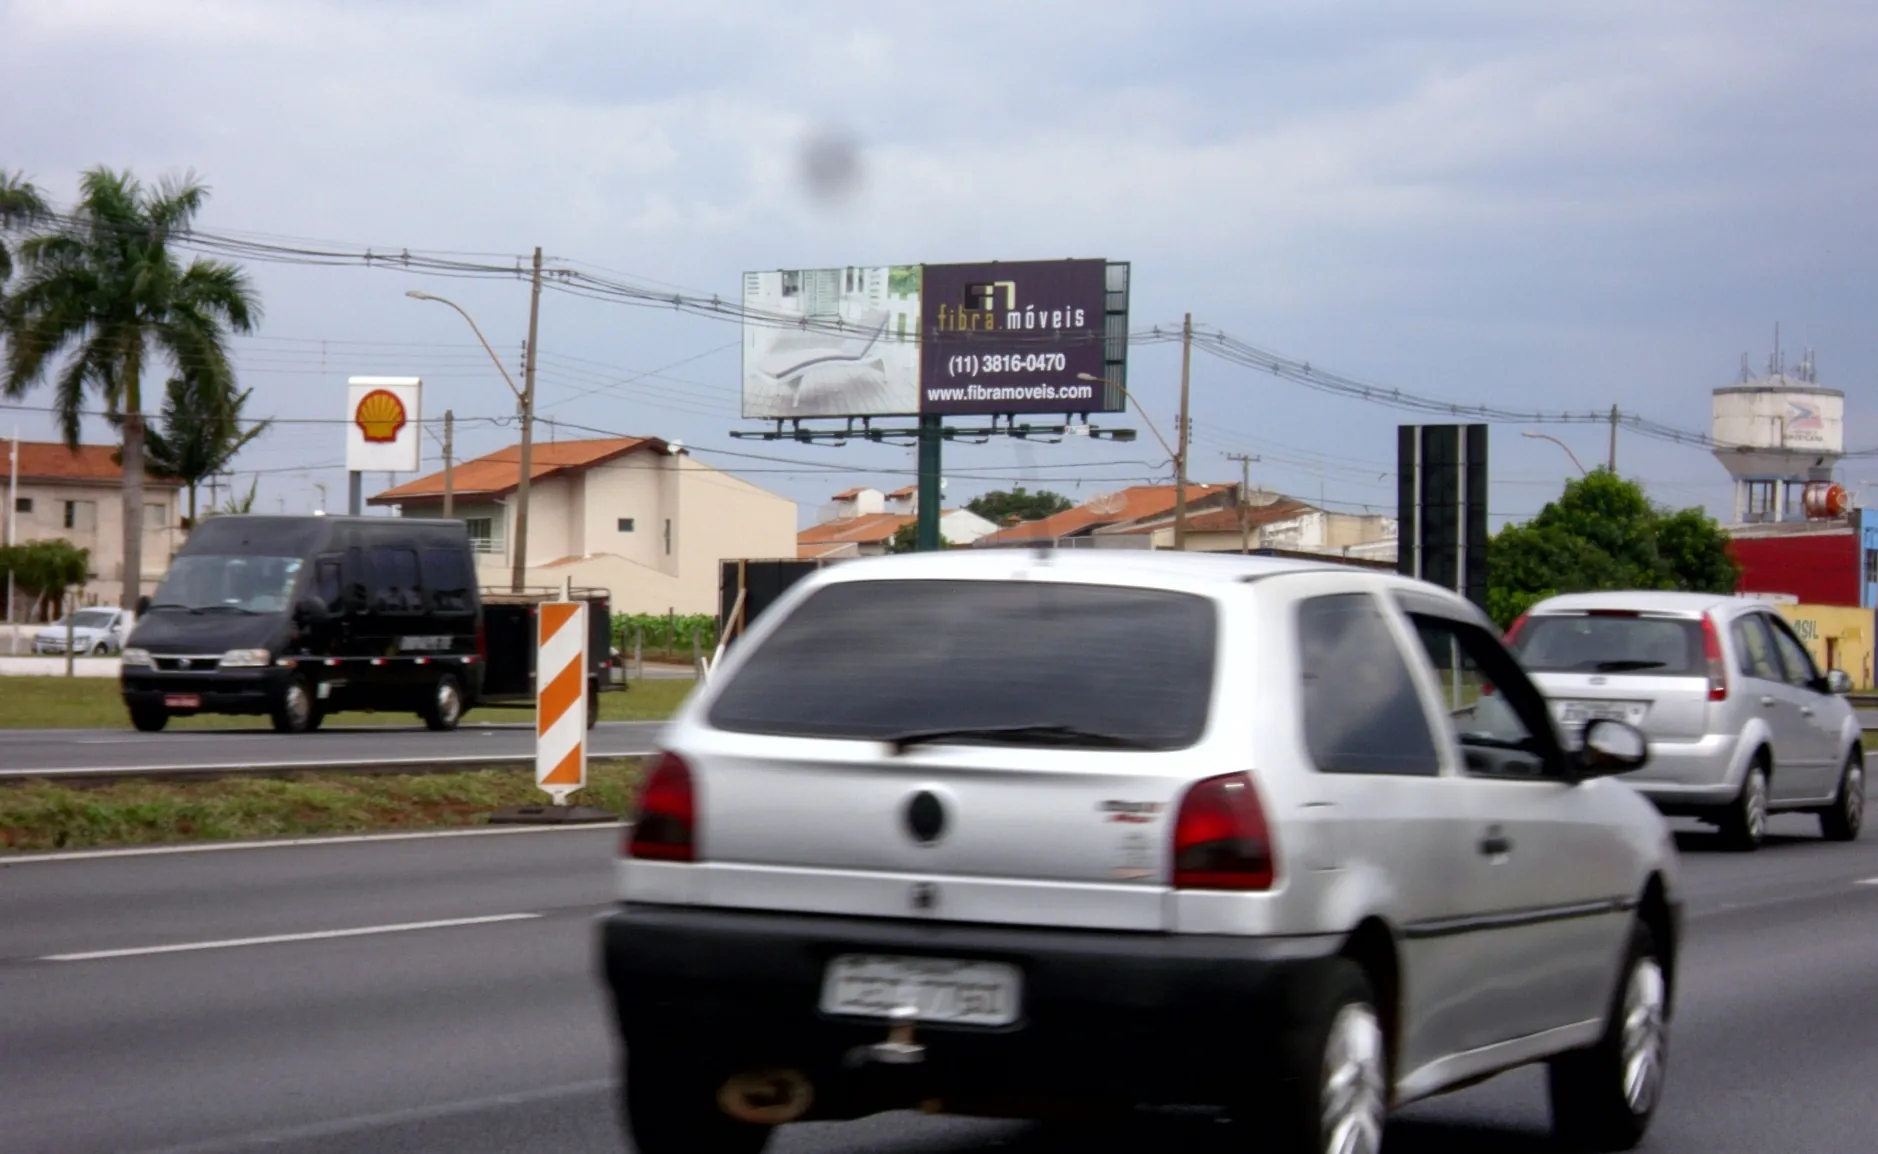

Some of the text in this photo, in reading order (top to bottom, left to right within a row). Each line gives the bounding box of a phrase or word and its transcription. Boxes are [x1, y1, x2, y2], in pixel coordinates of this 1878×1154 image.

[1007, 304, 1085, 330] móveis
[948, 353, 1066, 376] (11) 3816-0470
[927, 383, 1093, 401] www.fibramoveis.com
